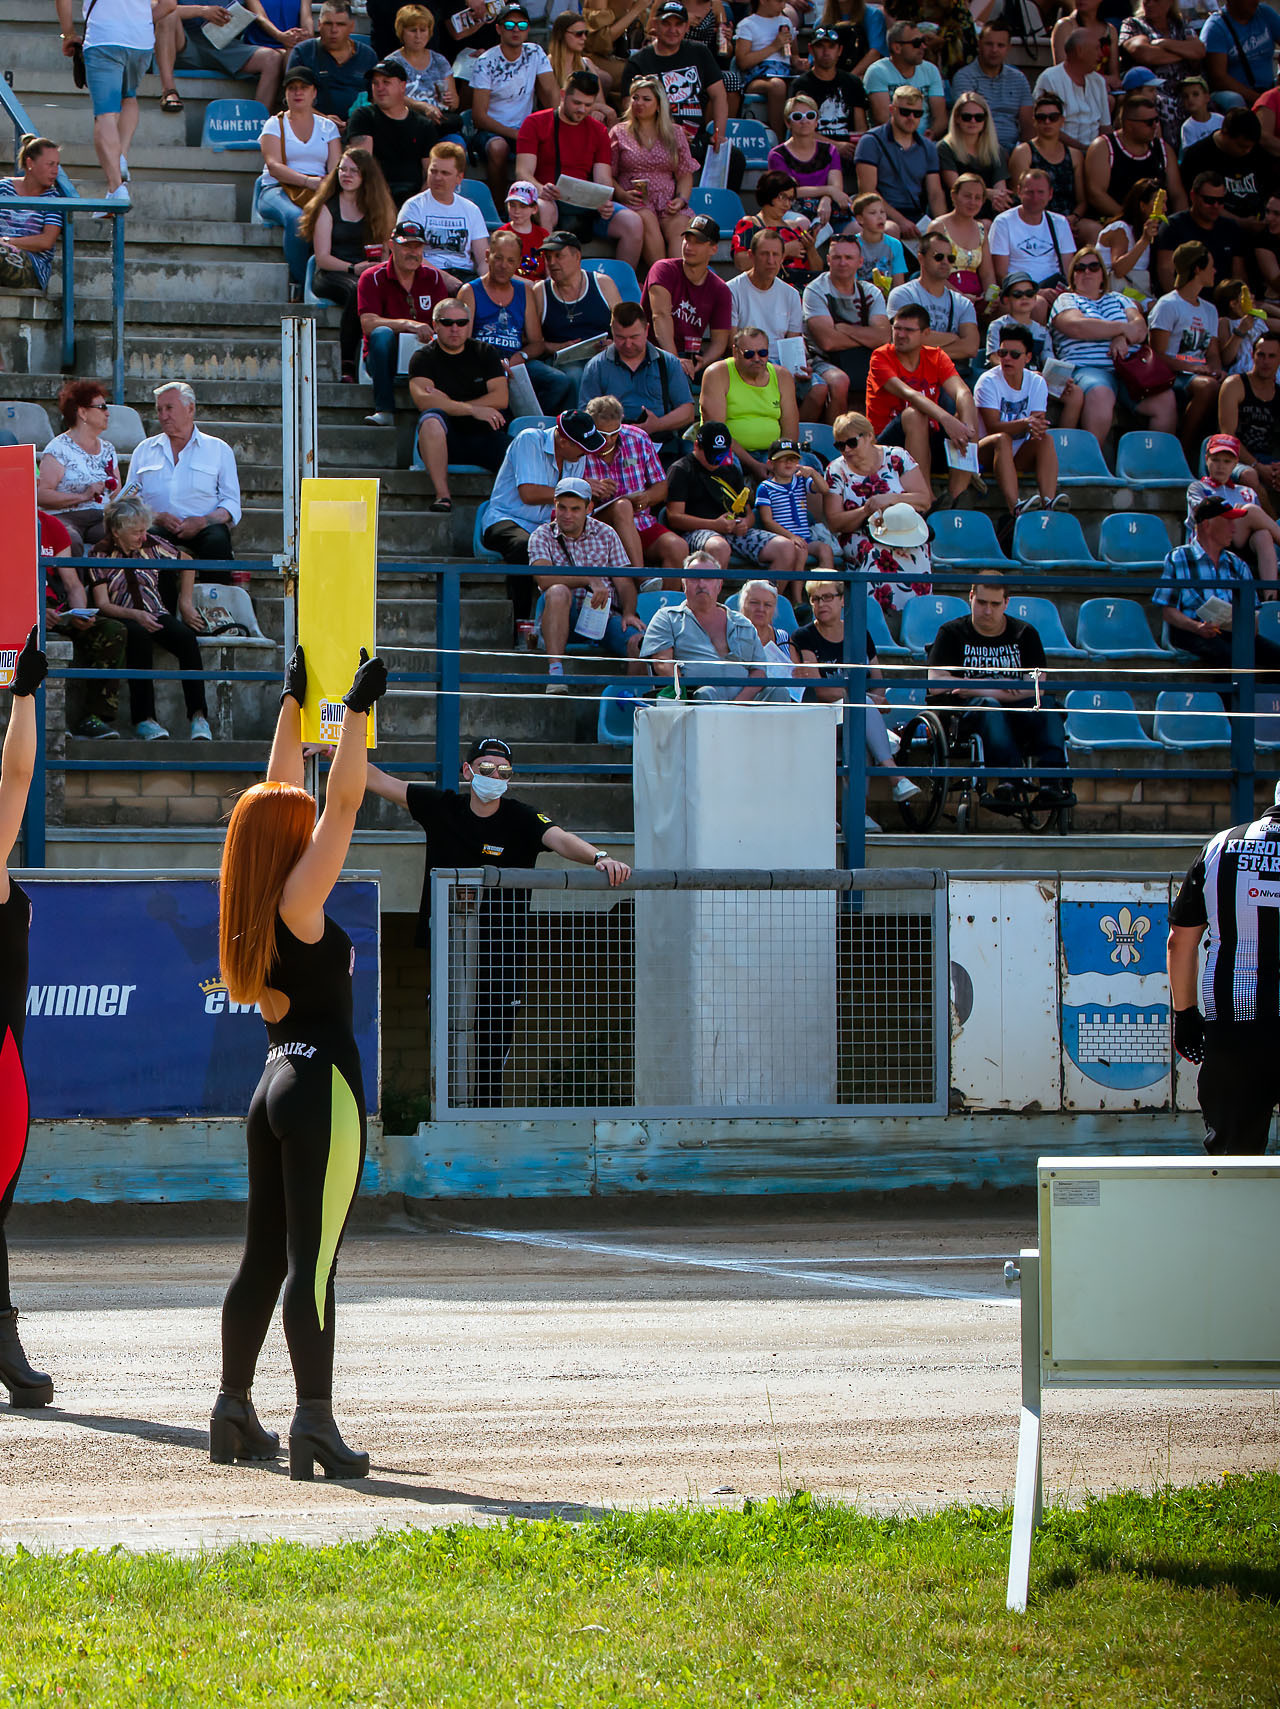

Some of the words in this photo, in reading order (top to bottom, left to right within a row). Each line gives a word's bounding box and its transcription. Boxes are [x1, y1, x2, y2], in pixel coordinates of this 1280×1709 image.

[4, 71, 13, 88] 9
[732, 122, 740, 135] 7
[726, 136, 766, 148] NENTS
[672, 307, 702, 327] ATVIA
[7, 407, 15, 418] 5
[805, 430, 813, 442] 5
[1040, 516, 1049, 529] 7
[210, 588, 218, 600] 6
[935, 601, 943, 614] 5
[1106, 605, 1114, 618] 7
[964, 643, 1020, 657] DAUGAVPILS
[1093, 694, 1101, 707] 6
[1185, 692, 1194, 706] 7
[321, 704, 347, 722] ewinn
[26, 985, 137, 1017] winner
